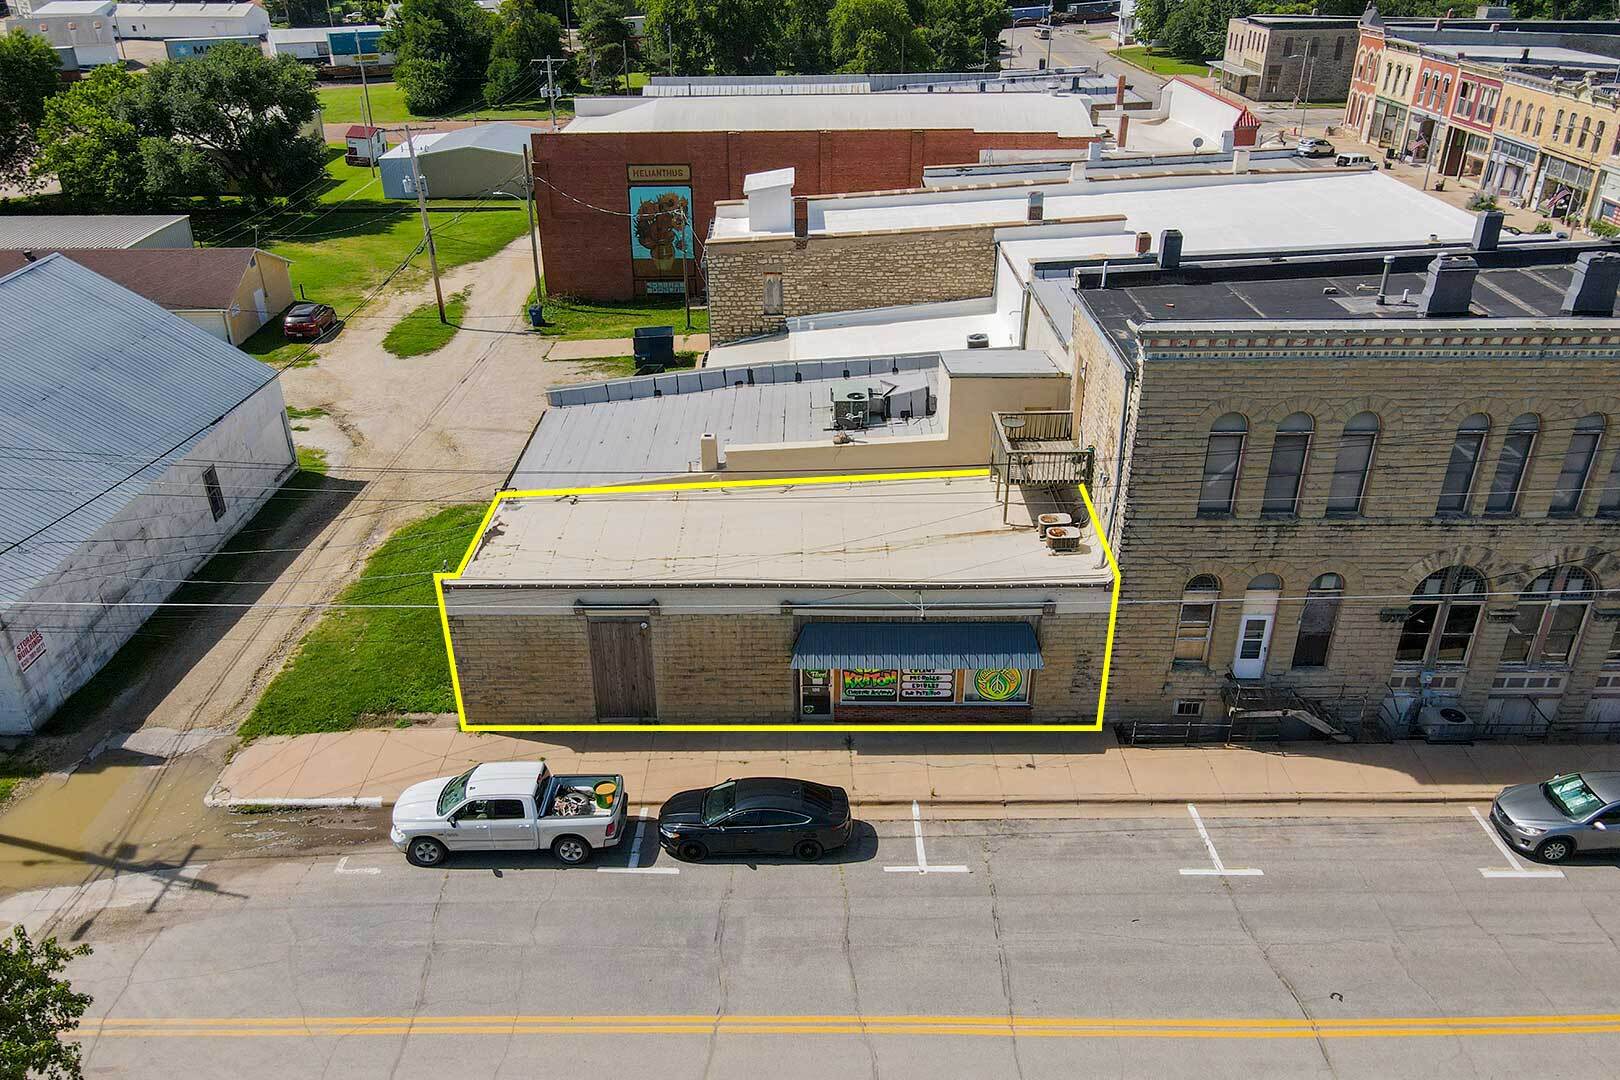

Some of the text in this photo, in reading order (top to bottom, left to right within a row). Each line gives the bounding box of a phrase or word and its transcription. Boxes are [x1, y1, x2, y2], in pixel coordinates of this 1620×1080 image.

[632, 168, 684, 177] HELIANTHUS
[17, 629, 39, 652] STORAGE
[17, 634, 43, 661] BUILDINGS
